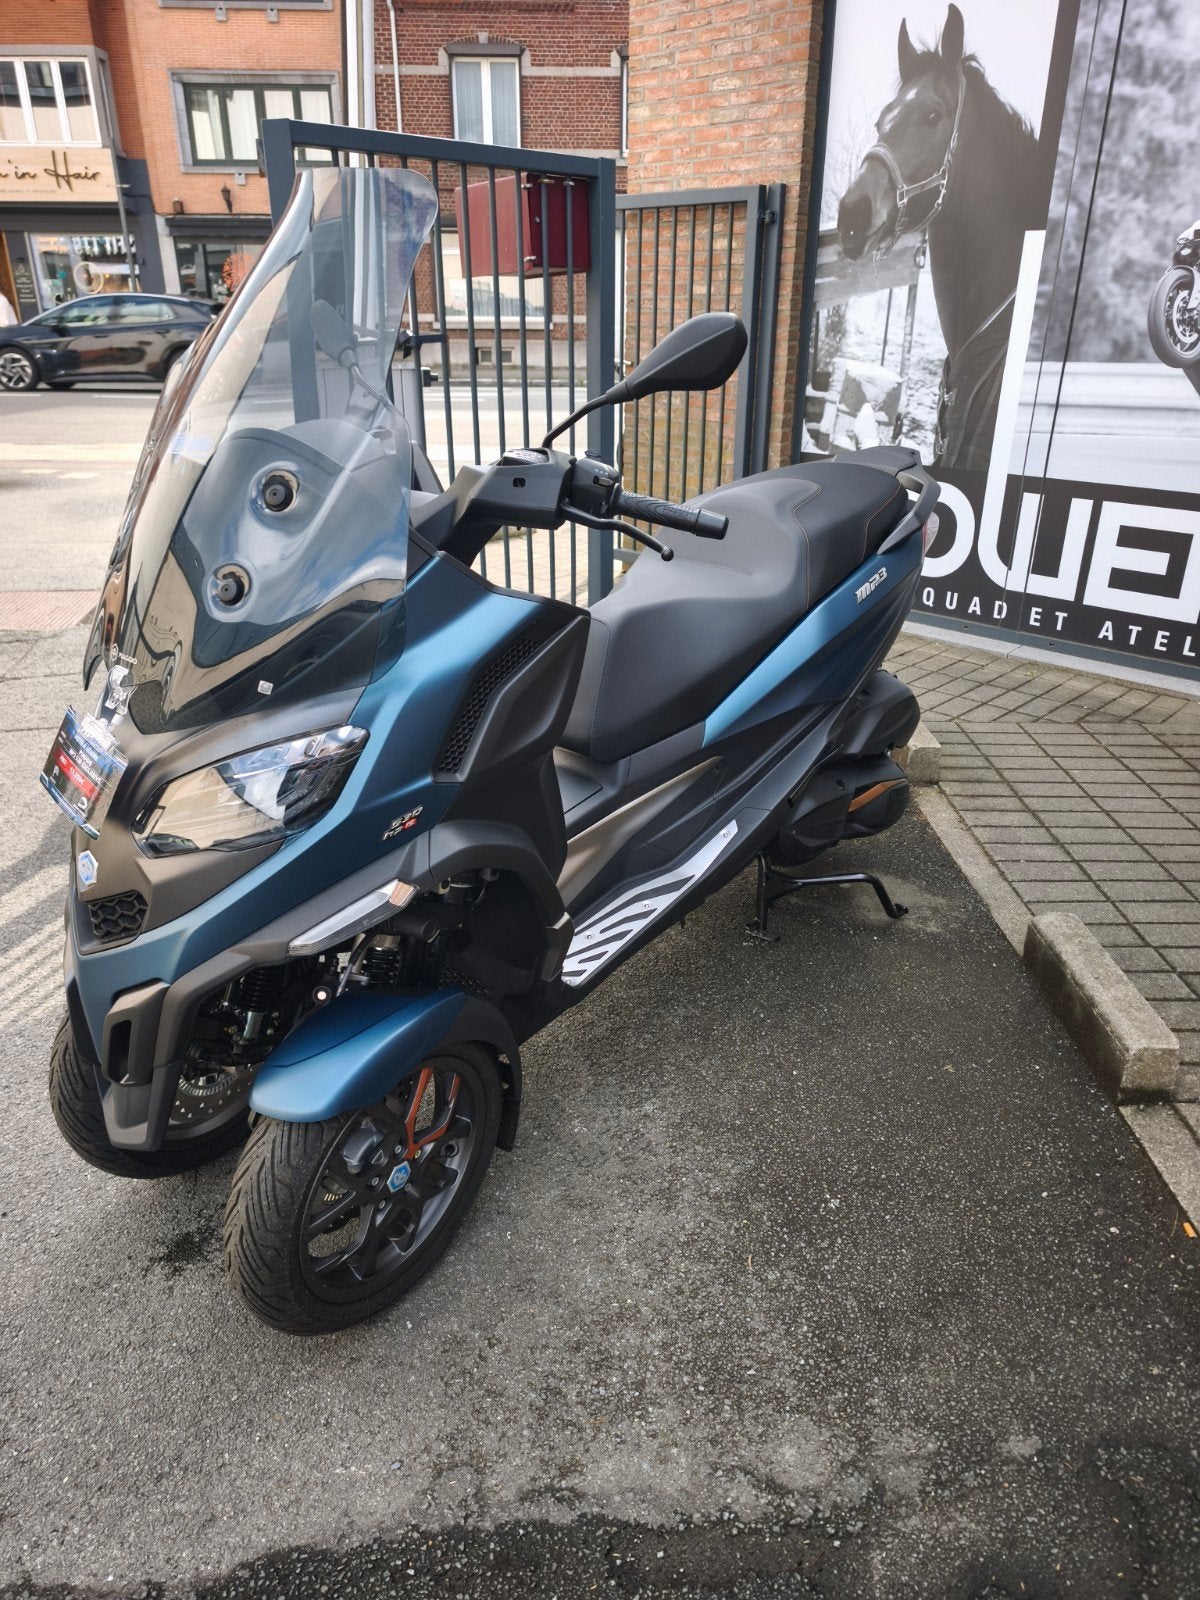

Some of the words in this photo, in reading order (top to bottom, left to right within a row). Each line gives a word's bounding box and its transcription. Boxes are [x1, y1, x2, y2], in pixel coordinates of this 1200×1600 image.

[43, 150, 101, 192] Hair
[854, 566, 888, 604] MP3
[922, 586, 1008, 619] QUAD
[1029, 606, 1068, 631] ET
